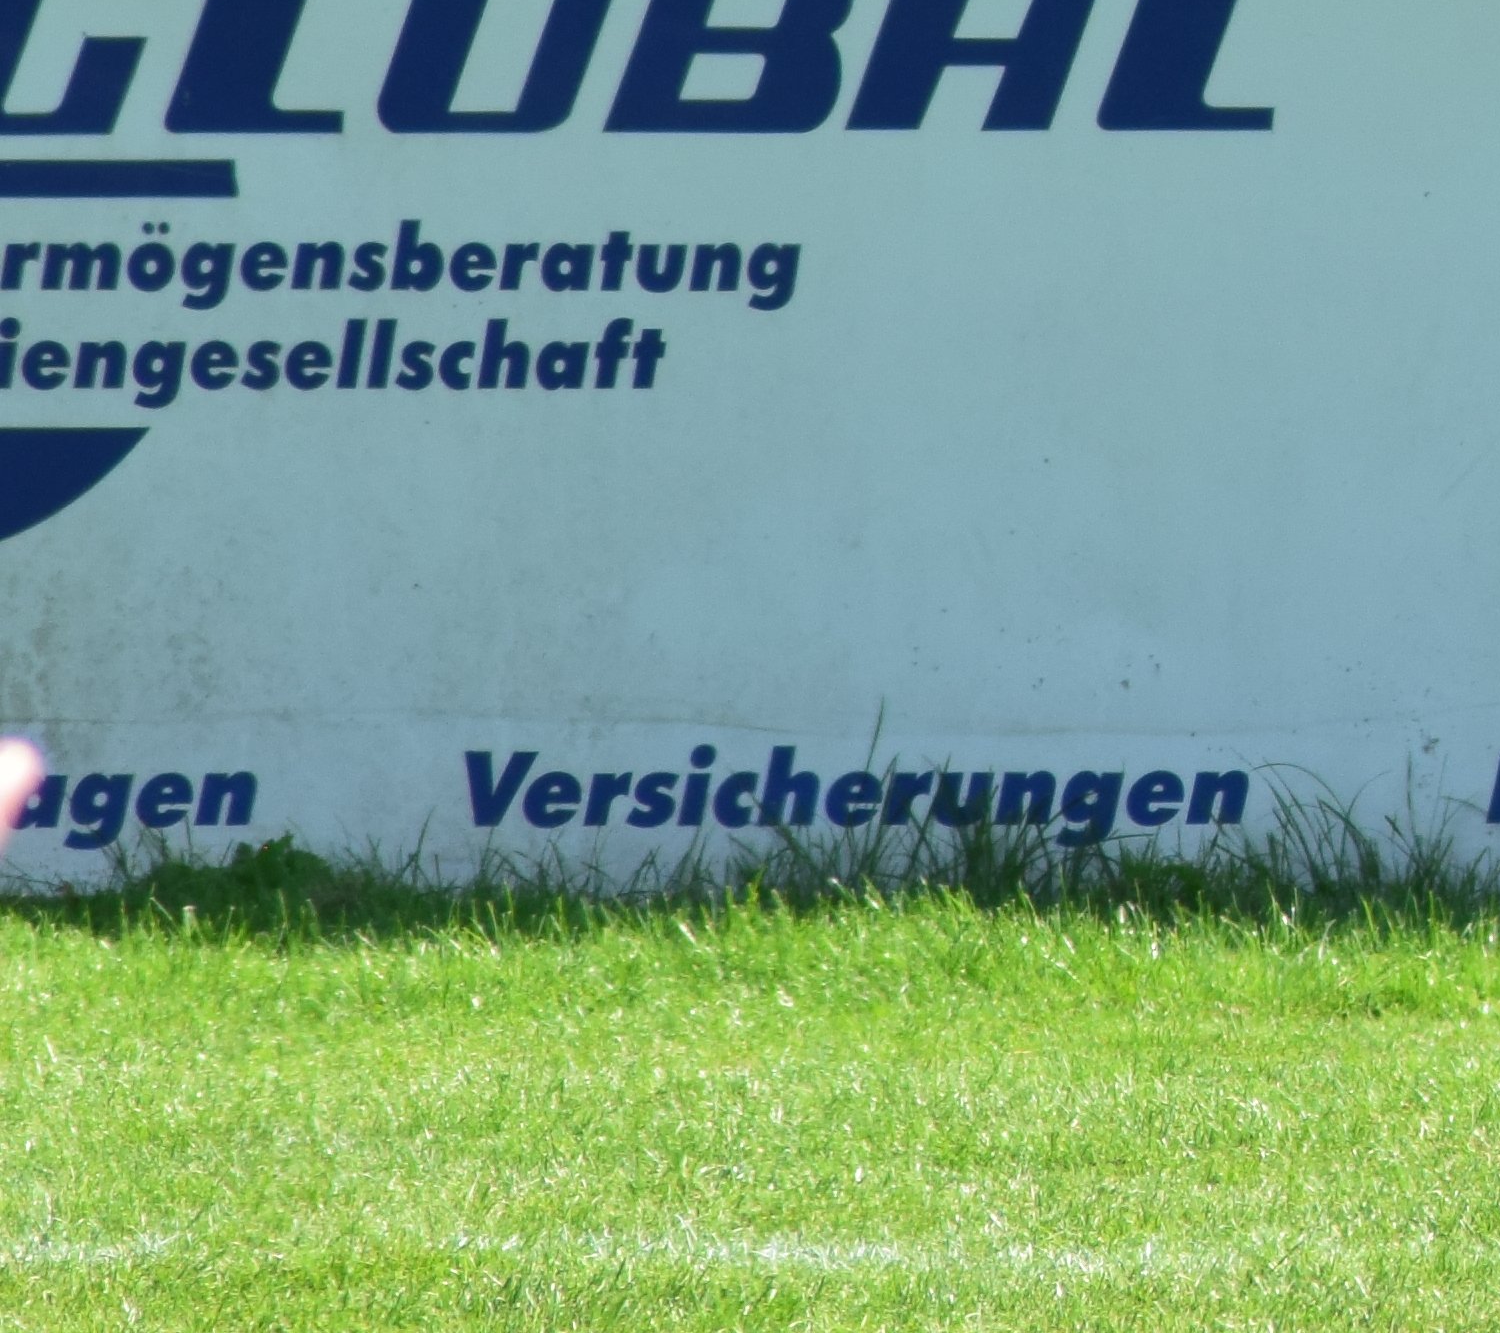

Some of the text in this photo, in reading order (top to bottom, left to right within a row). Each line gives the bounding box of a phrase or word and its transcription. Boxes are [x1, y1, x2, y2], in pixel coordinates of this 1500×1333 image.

[0, 220, 801, 310] rmögensberatung
[0, 317, 666, 409] iengesellschaft
[12, 771, 259, 850] agen
[464, 744, 1250, 848] Versicherungen
